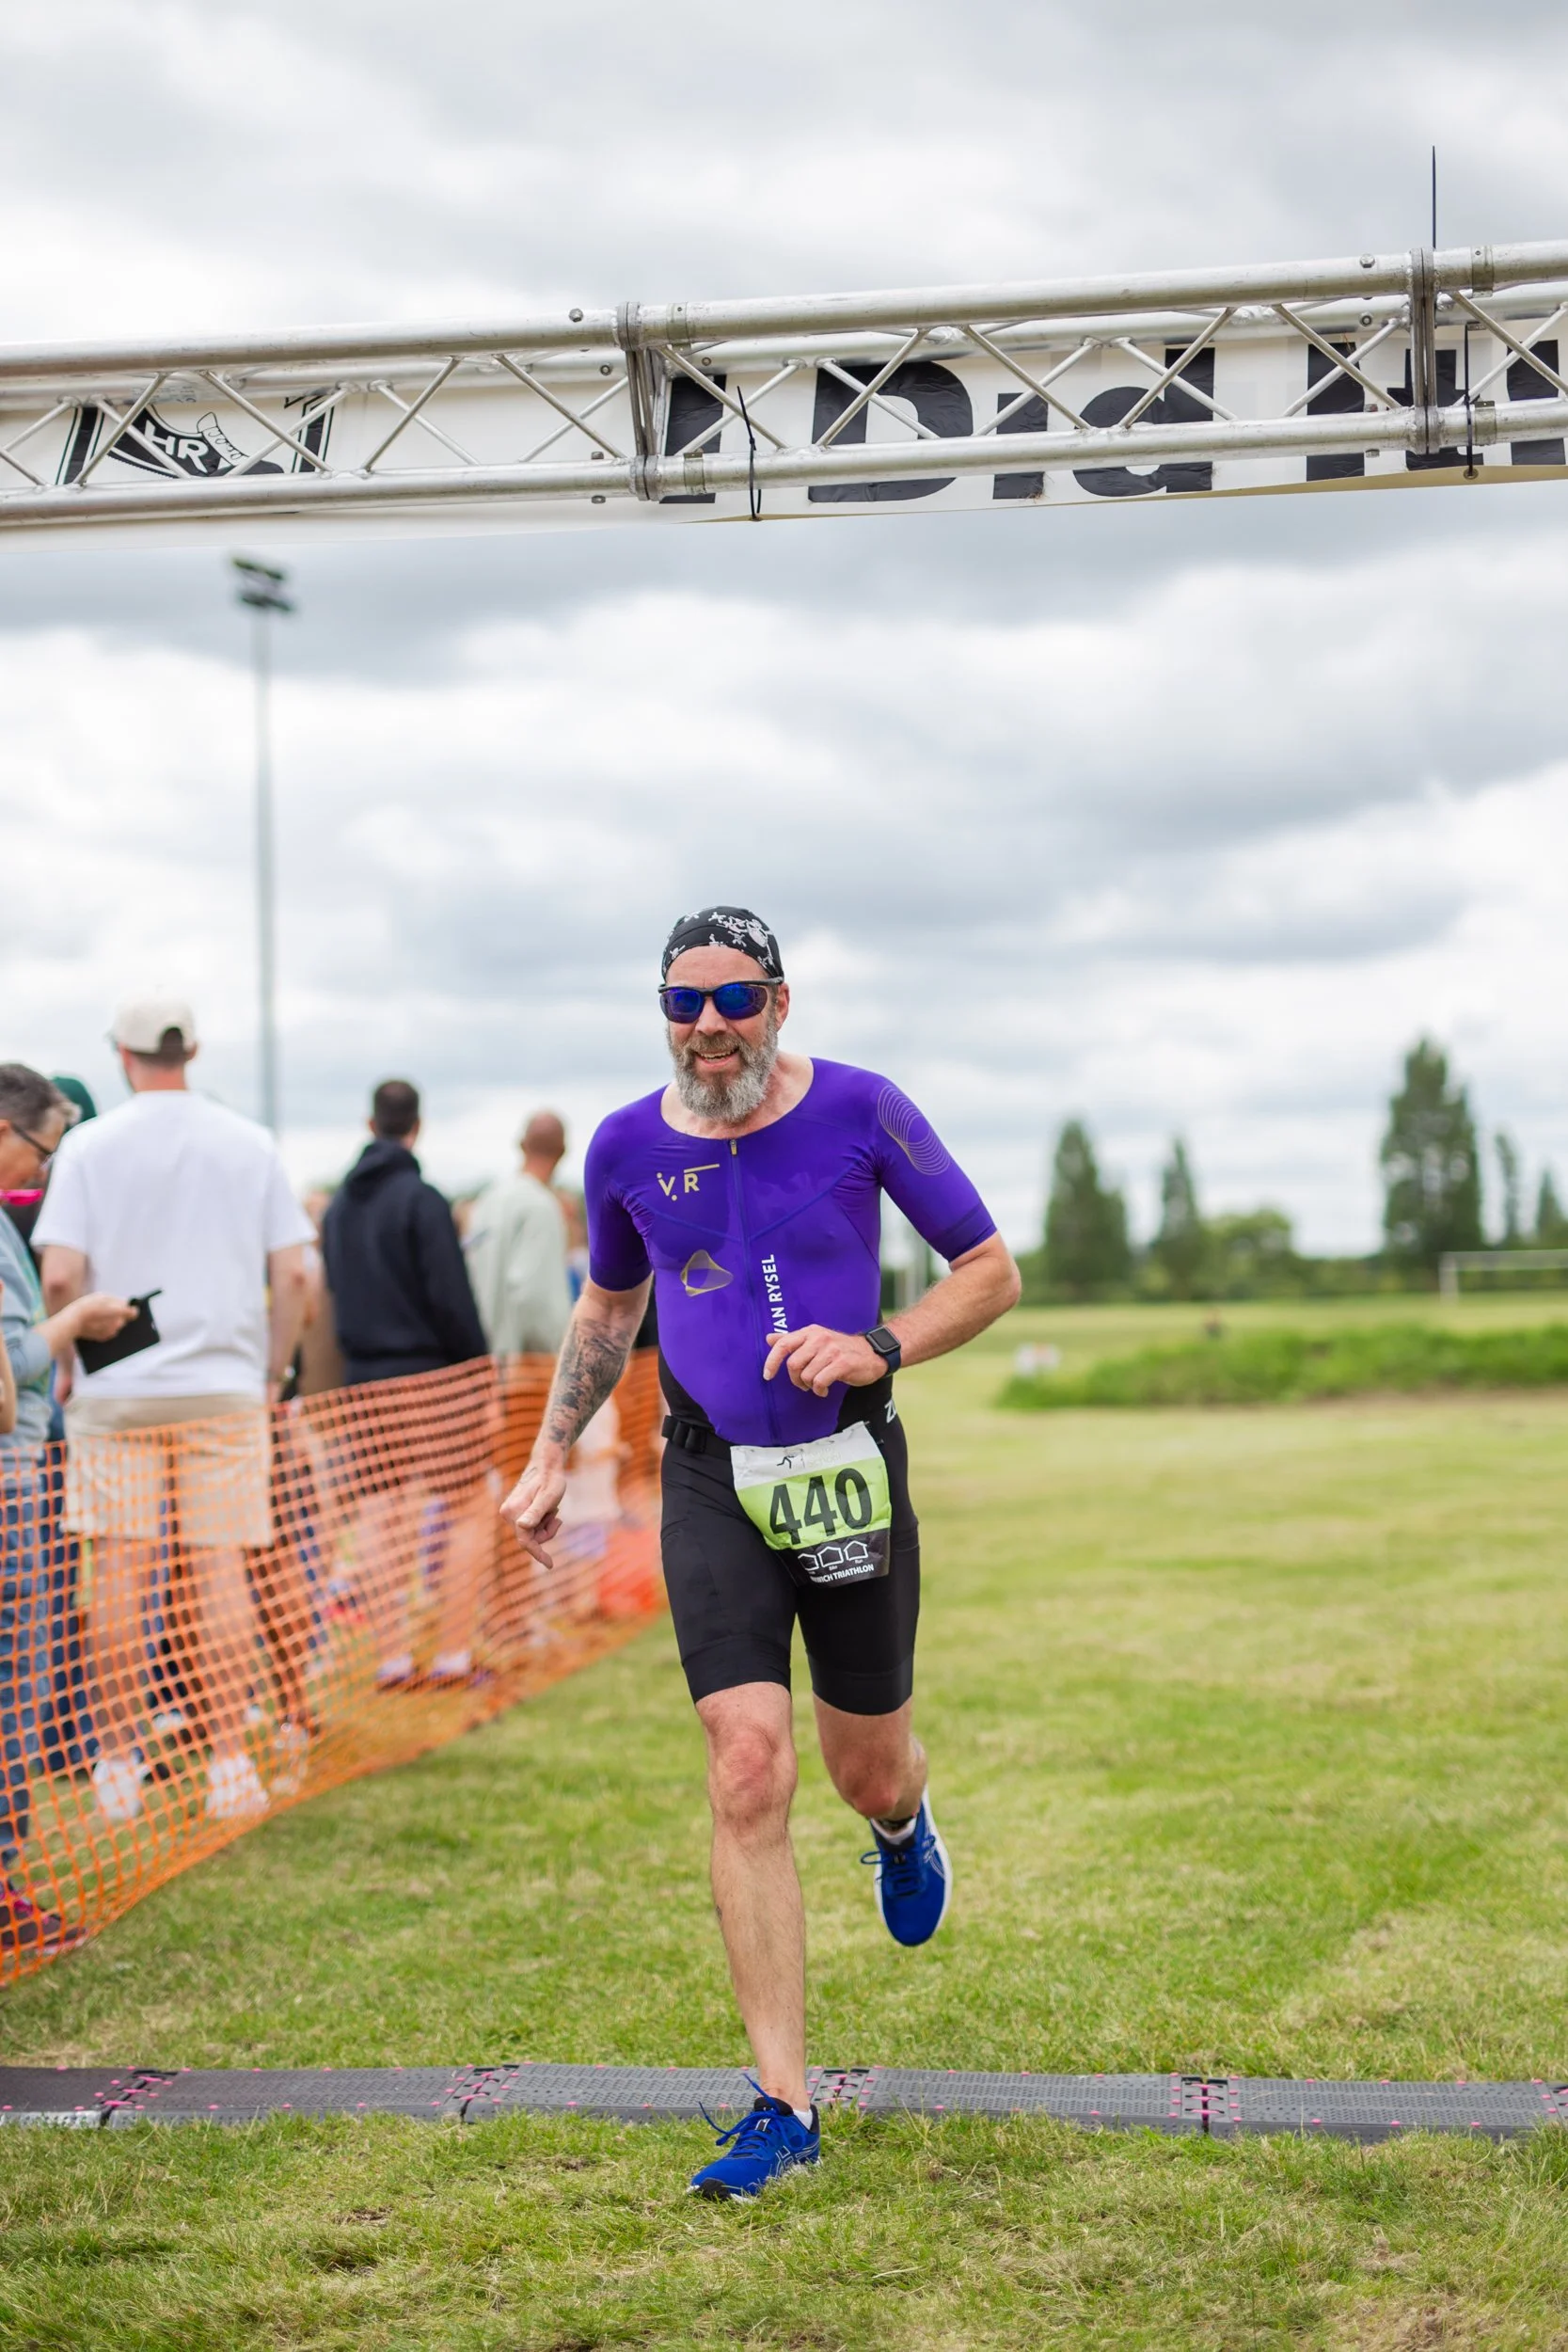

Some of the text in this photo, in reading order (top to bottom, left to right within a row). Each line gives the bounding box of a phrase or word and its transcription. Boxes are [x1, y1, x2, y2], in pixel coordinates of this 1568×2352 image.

[761, 1254, 783, 1303] RYSEL
[769, 1468, 872, 1545] 440
[833, 1564, 875, 1581] TRIATHLON
